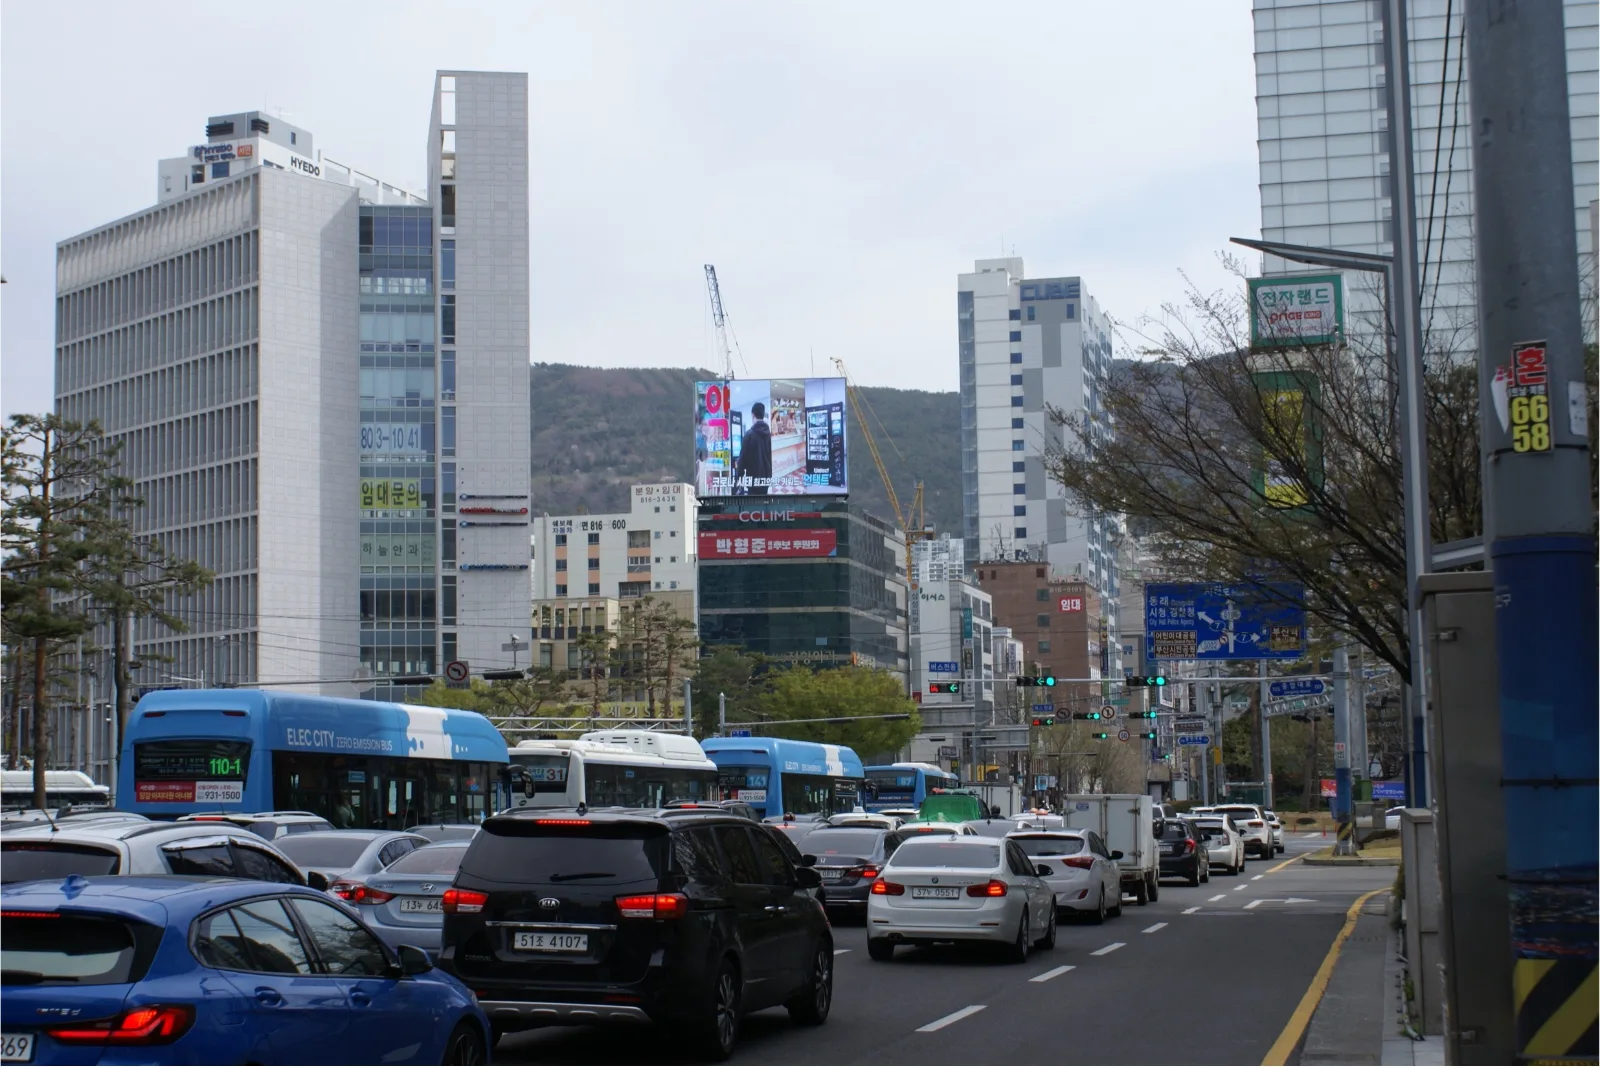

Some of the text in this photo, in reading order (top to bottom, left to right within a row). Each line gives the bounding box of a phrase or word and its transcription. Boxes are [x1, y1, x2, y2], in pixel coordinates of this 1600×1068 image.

[291, 156, 320, 176] HYEDO
[1262, 288, 1330, 307] 전자랜드
[1512, 395, 1548, 424] 66
[361, 427, 419, 449] 803-1041
[1513, 423, 1550, 452] 58
[712, 476, 735, 487] 코로나
[361, 481, 419, 506] 임대문의
[739, 510, 795, 522] CCLIME
[362, 542, 419, 556] 하늘안과
[716, 538, 766, 554] 박형준
[793, 540, 819, 549] 후원회
[1060, 598, 1081, 611] 임대
[1155, 631, 1196, 640] 어린이대공원
[1155, 645, 1196, 654] 부산시민공원
[930, 663, 958, 672] 버스전용
[286, 727, 393, 751] ELEC CITY ZERO EMISSION BUS
[210, 758, 240, 775] 110-1
[546, 768, 564, 781] 31
[749, 776, 766, 787] 141
[901, 777, 912, 786] 87
[205, 791, 240, 800] 931-1500
[934, 888, 955, 897] 0551
[520, 934, 582, 949] 51조 4107
